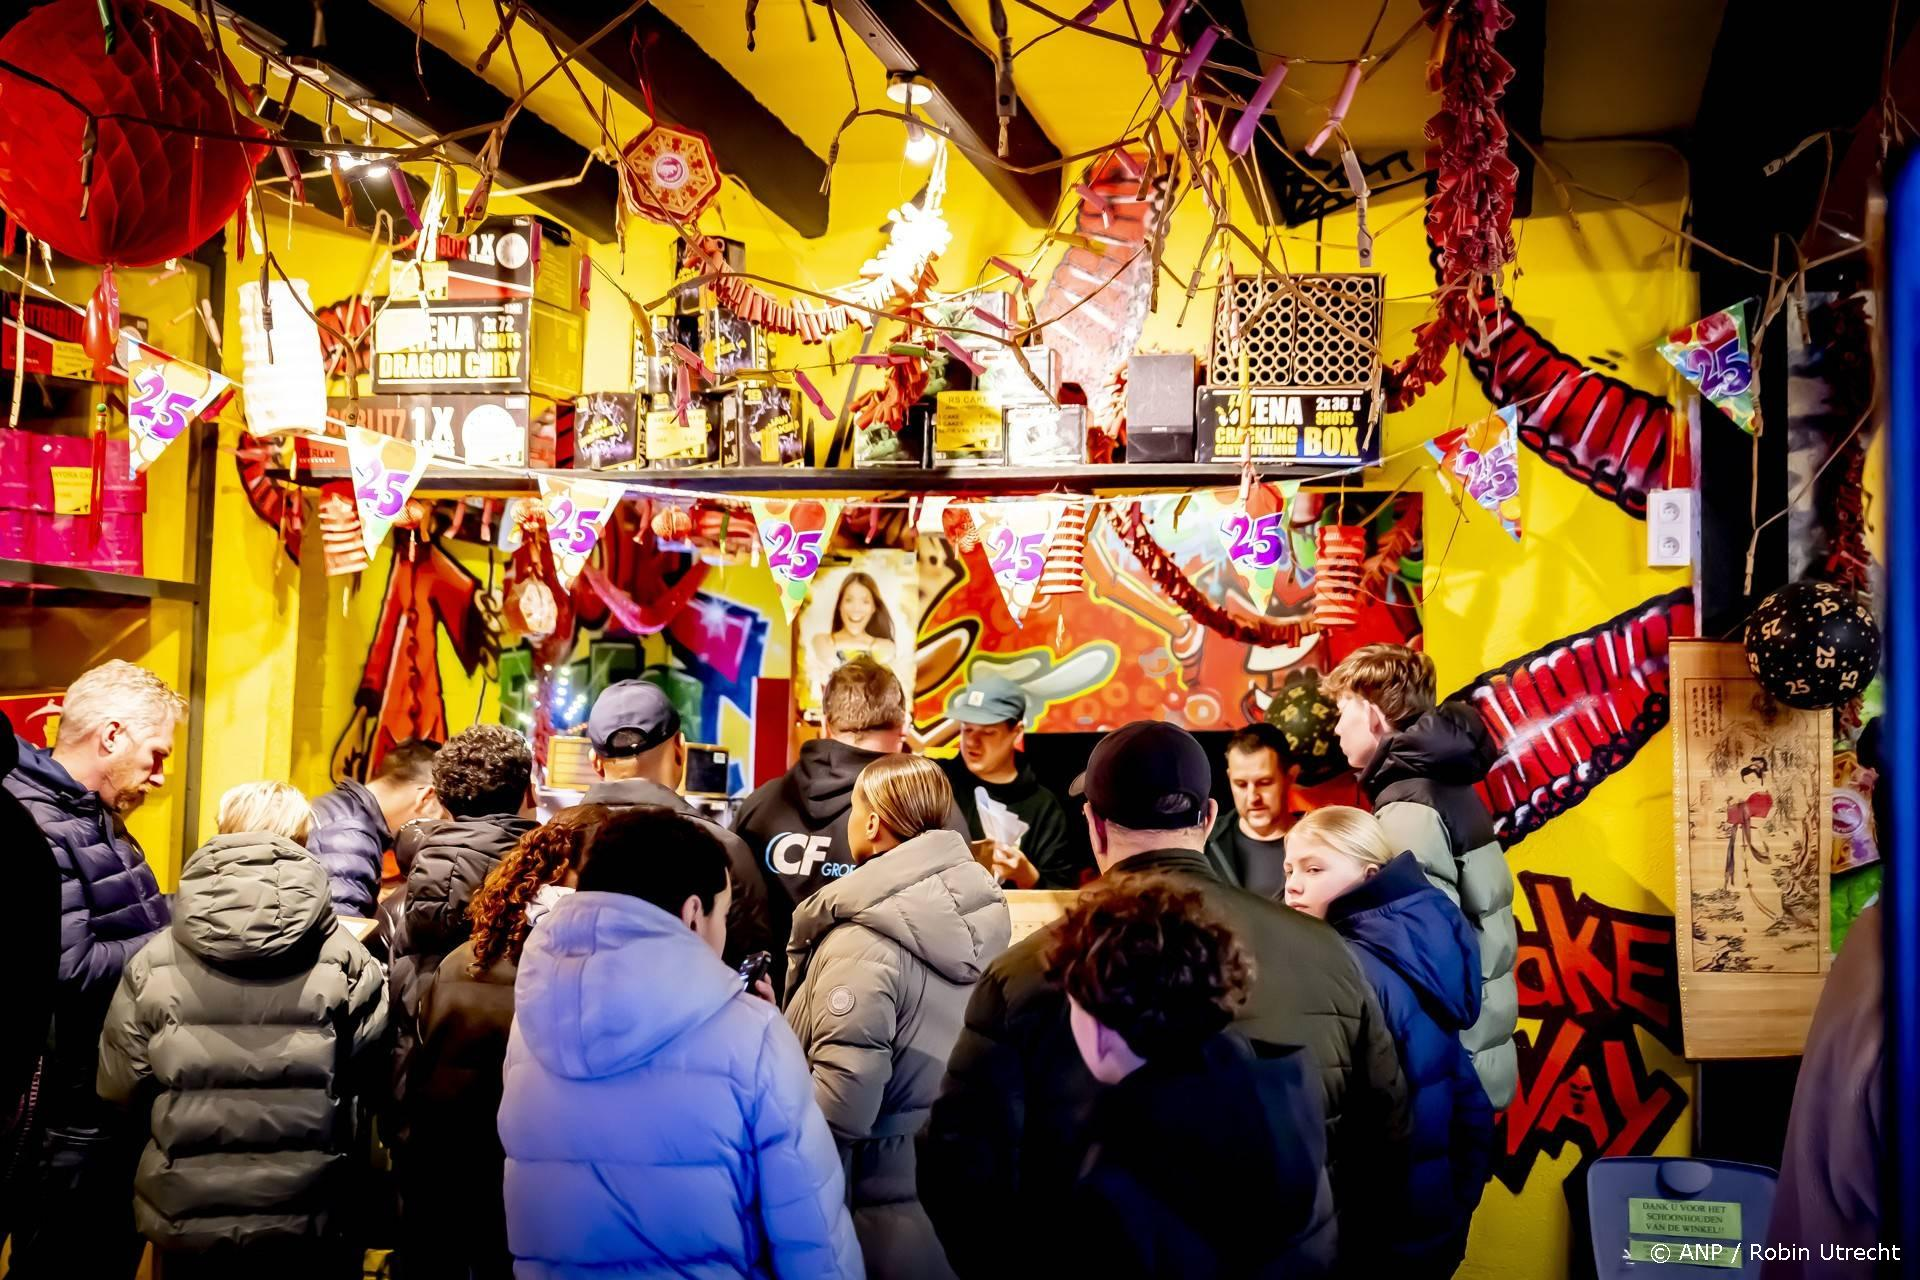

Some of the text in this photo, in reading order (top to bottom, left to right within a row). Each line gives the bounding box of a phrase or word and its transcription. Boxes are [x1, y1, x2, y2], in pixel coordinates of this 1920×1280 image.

[427, 315, 476, 350] ENA
[498, 315, 515, 331] 72
[481, 332, 522, 349] SHOTS
[378, 352, 462, 378] DRAGON
[1686, 336, 1752, 397] 25
[130, 367, 198, 440] 25
[1332, 397, 1349, 411] 36
[1315, 412, 1354, 426] SHOTS
[1304, 427, 1358, 456] BOX
[1456, 440, 1519, 502] 25
[357, 460, 410, 516] 25
[549, 498, 599, 553] 25
[1221, 512, 1284, 566] 25
[769, 523, 823, 581] 25
[990, 527, 1046, 583] 25
[1814, 598, 1839, 616] 25
[1761, 618, 1781, 640] 25
[1816, 646, 1836, 669] 25
[1785, 679, 1810, 694] 25
[1839, 670, 1859, 691] 25
[773, 833, 832, 876] CF
[1642, 1202, 1669, 1211] DANK
[1680, 1203, 1706, 1212] VOOR
[1708, 1205, 1726, 1214] HET
[1646, 1212, 1723, 1223] SCHOONHOUDEN
[1645, 1222, 1666, 1232] VAN
[1668, 1223, 1680, 1232] DE
